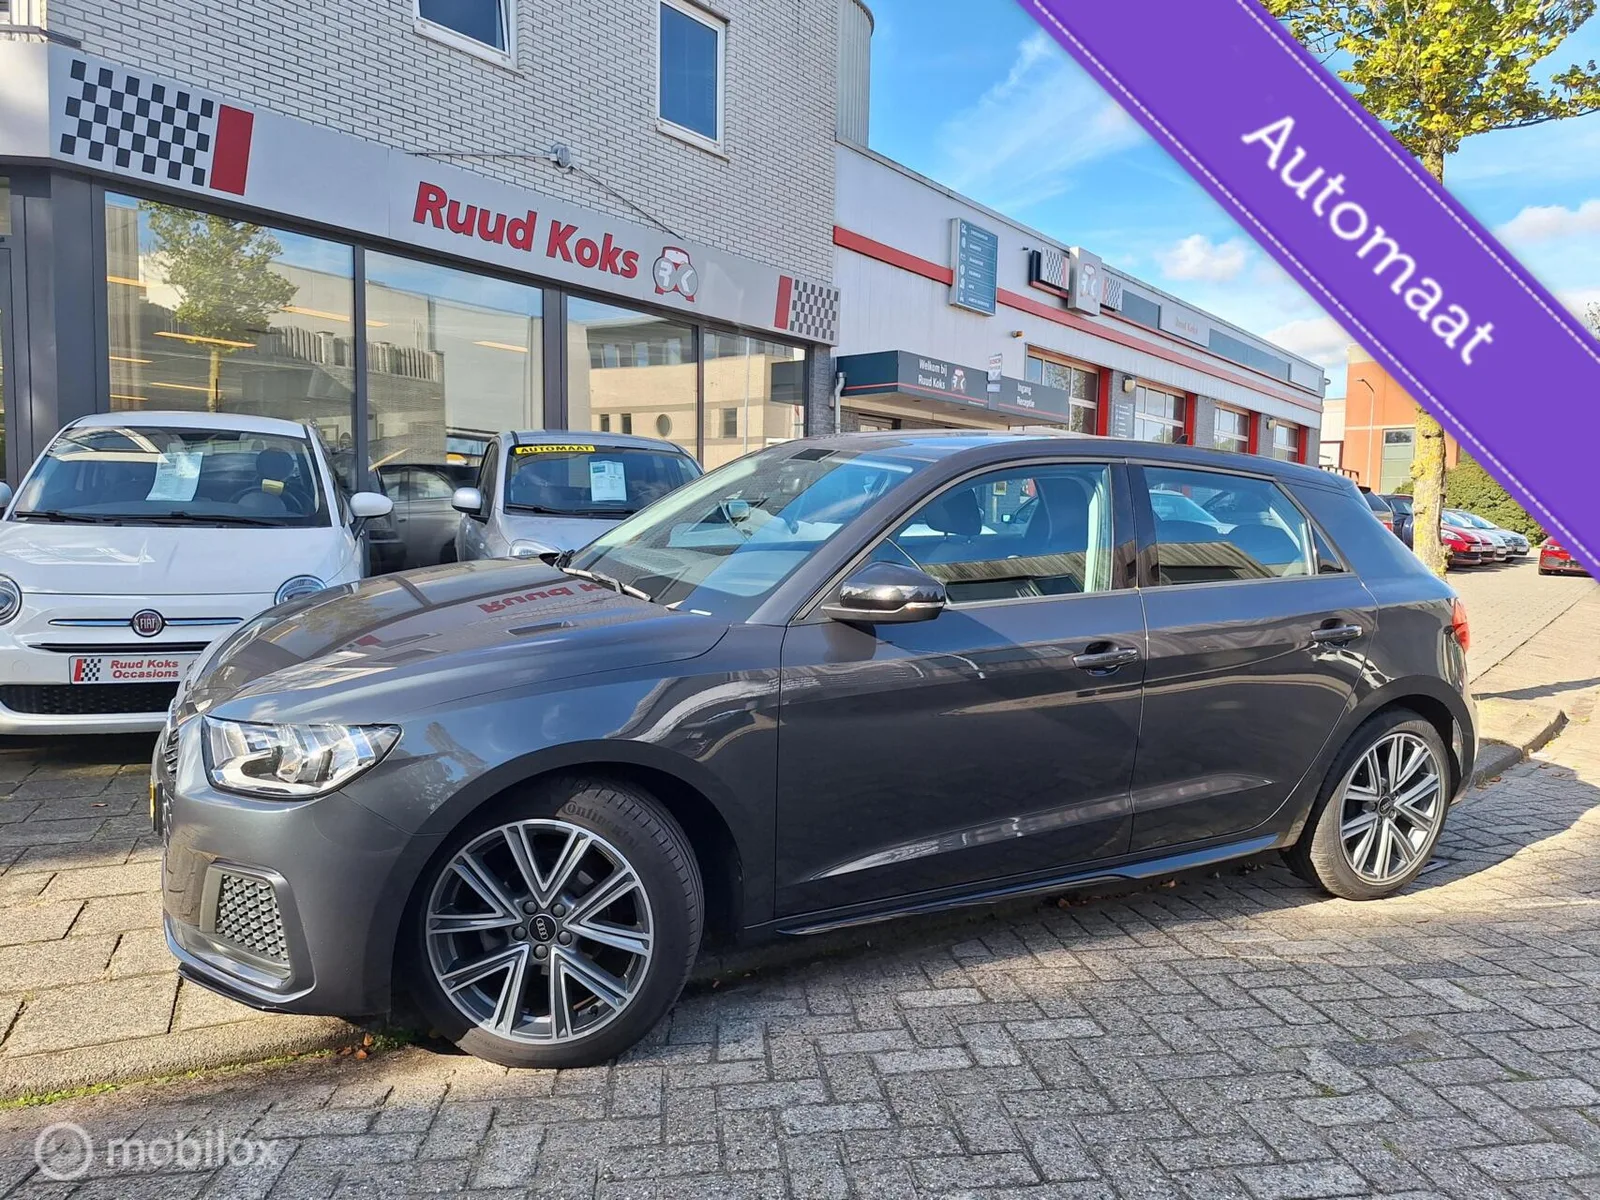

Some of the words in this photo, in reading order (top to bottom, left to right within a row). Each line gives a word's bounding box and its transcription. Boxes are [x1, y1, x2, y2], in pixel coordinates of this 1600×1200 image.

[413, 181, 538, 252] Ruud
[546, 219, 640, 279] Koks
[918, 358, 940, 374] Welkom
[940, 365, 948, 377] bij
[918, 374, 932, 387] Ruud
[932, 377, 946, 390] Koks
[521, 445, 590, 454] AUTOMAAT
[140, 618, 156, 629] FIAT
[110, 660, 144, 669] Ruud
[147, 659, 179, 669] Koks
[112, 669, 179, 679] Occasions
